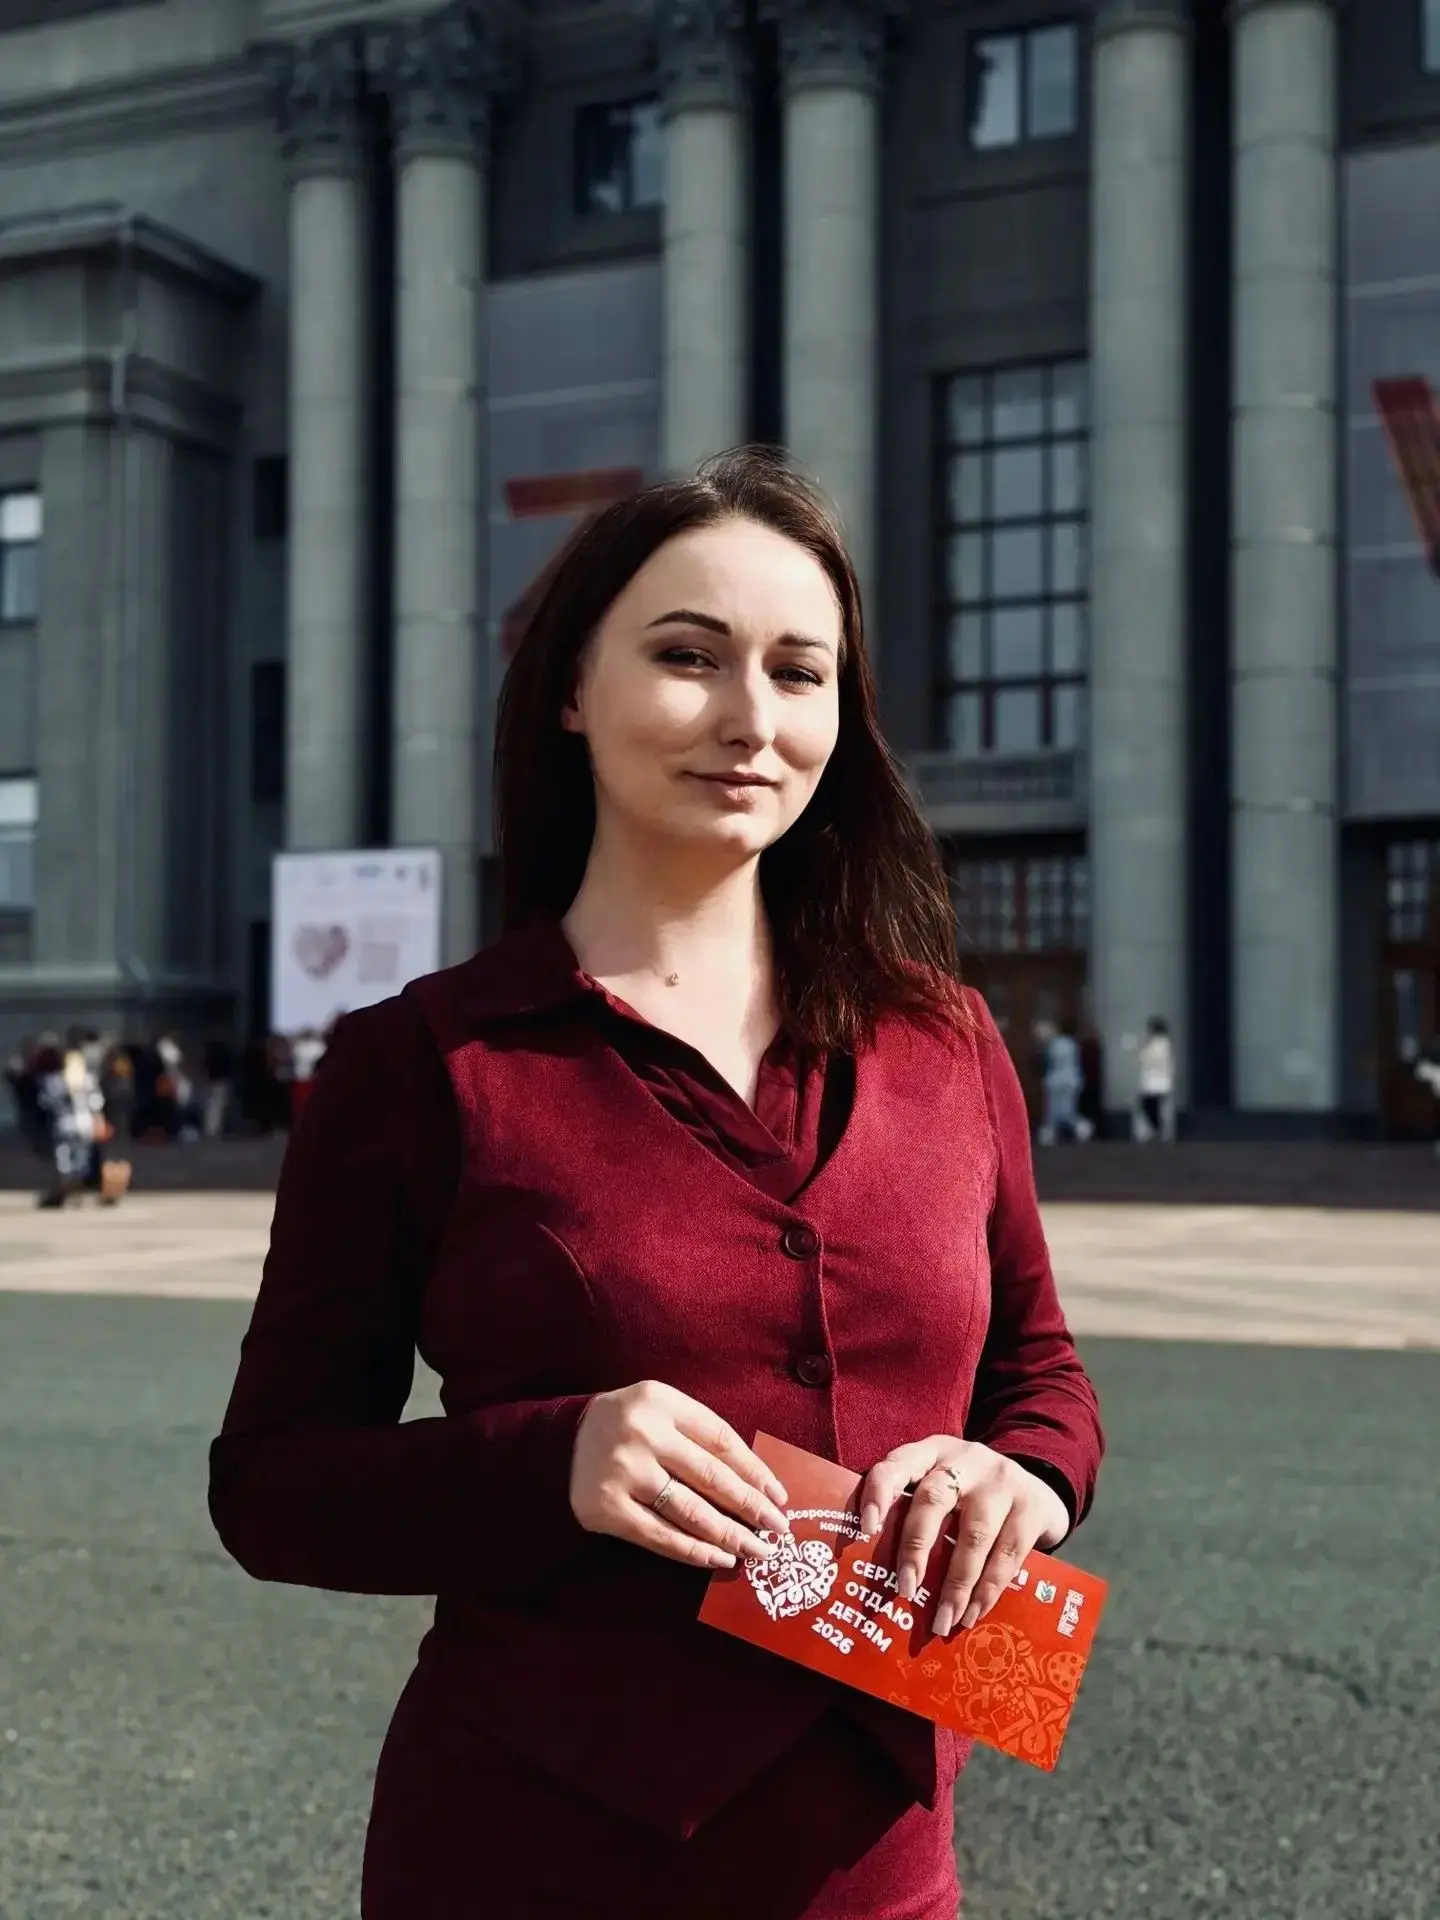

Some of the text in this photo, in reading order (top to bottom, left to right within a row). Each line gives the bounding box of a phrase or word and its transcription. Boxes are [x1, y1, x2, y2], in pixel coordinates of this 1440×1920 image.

[819, 1521, 871, 1543] конкурс
[845, 1581, 914, 1631] ОТДАЮ
[852, 1559, 931, 1608] СЕРДЕ
[811, 1617, 855, 1655] 2026
[827, 1600, 893, 1653] ДЕТЯМ
